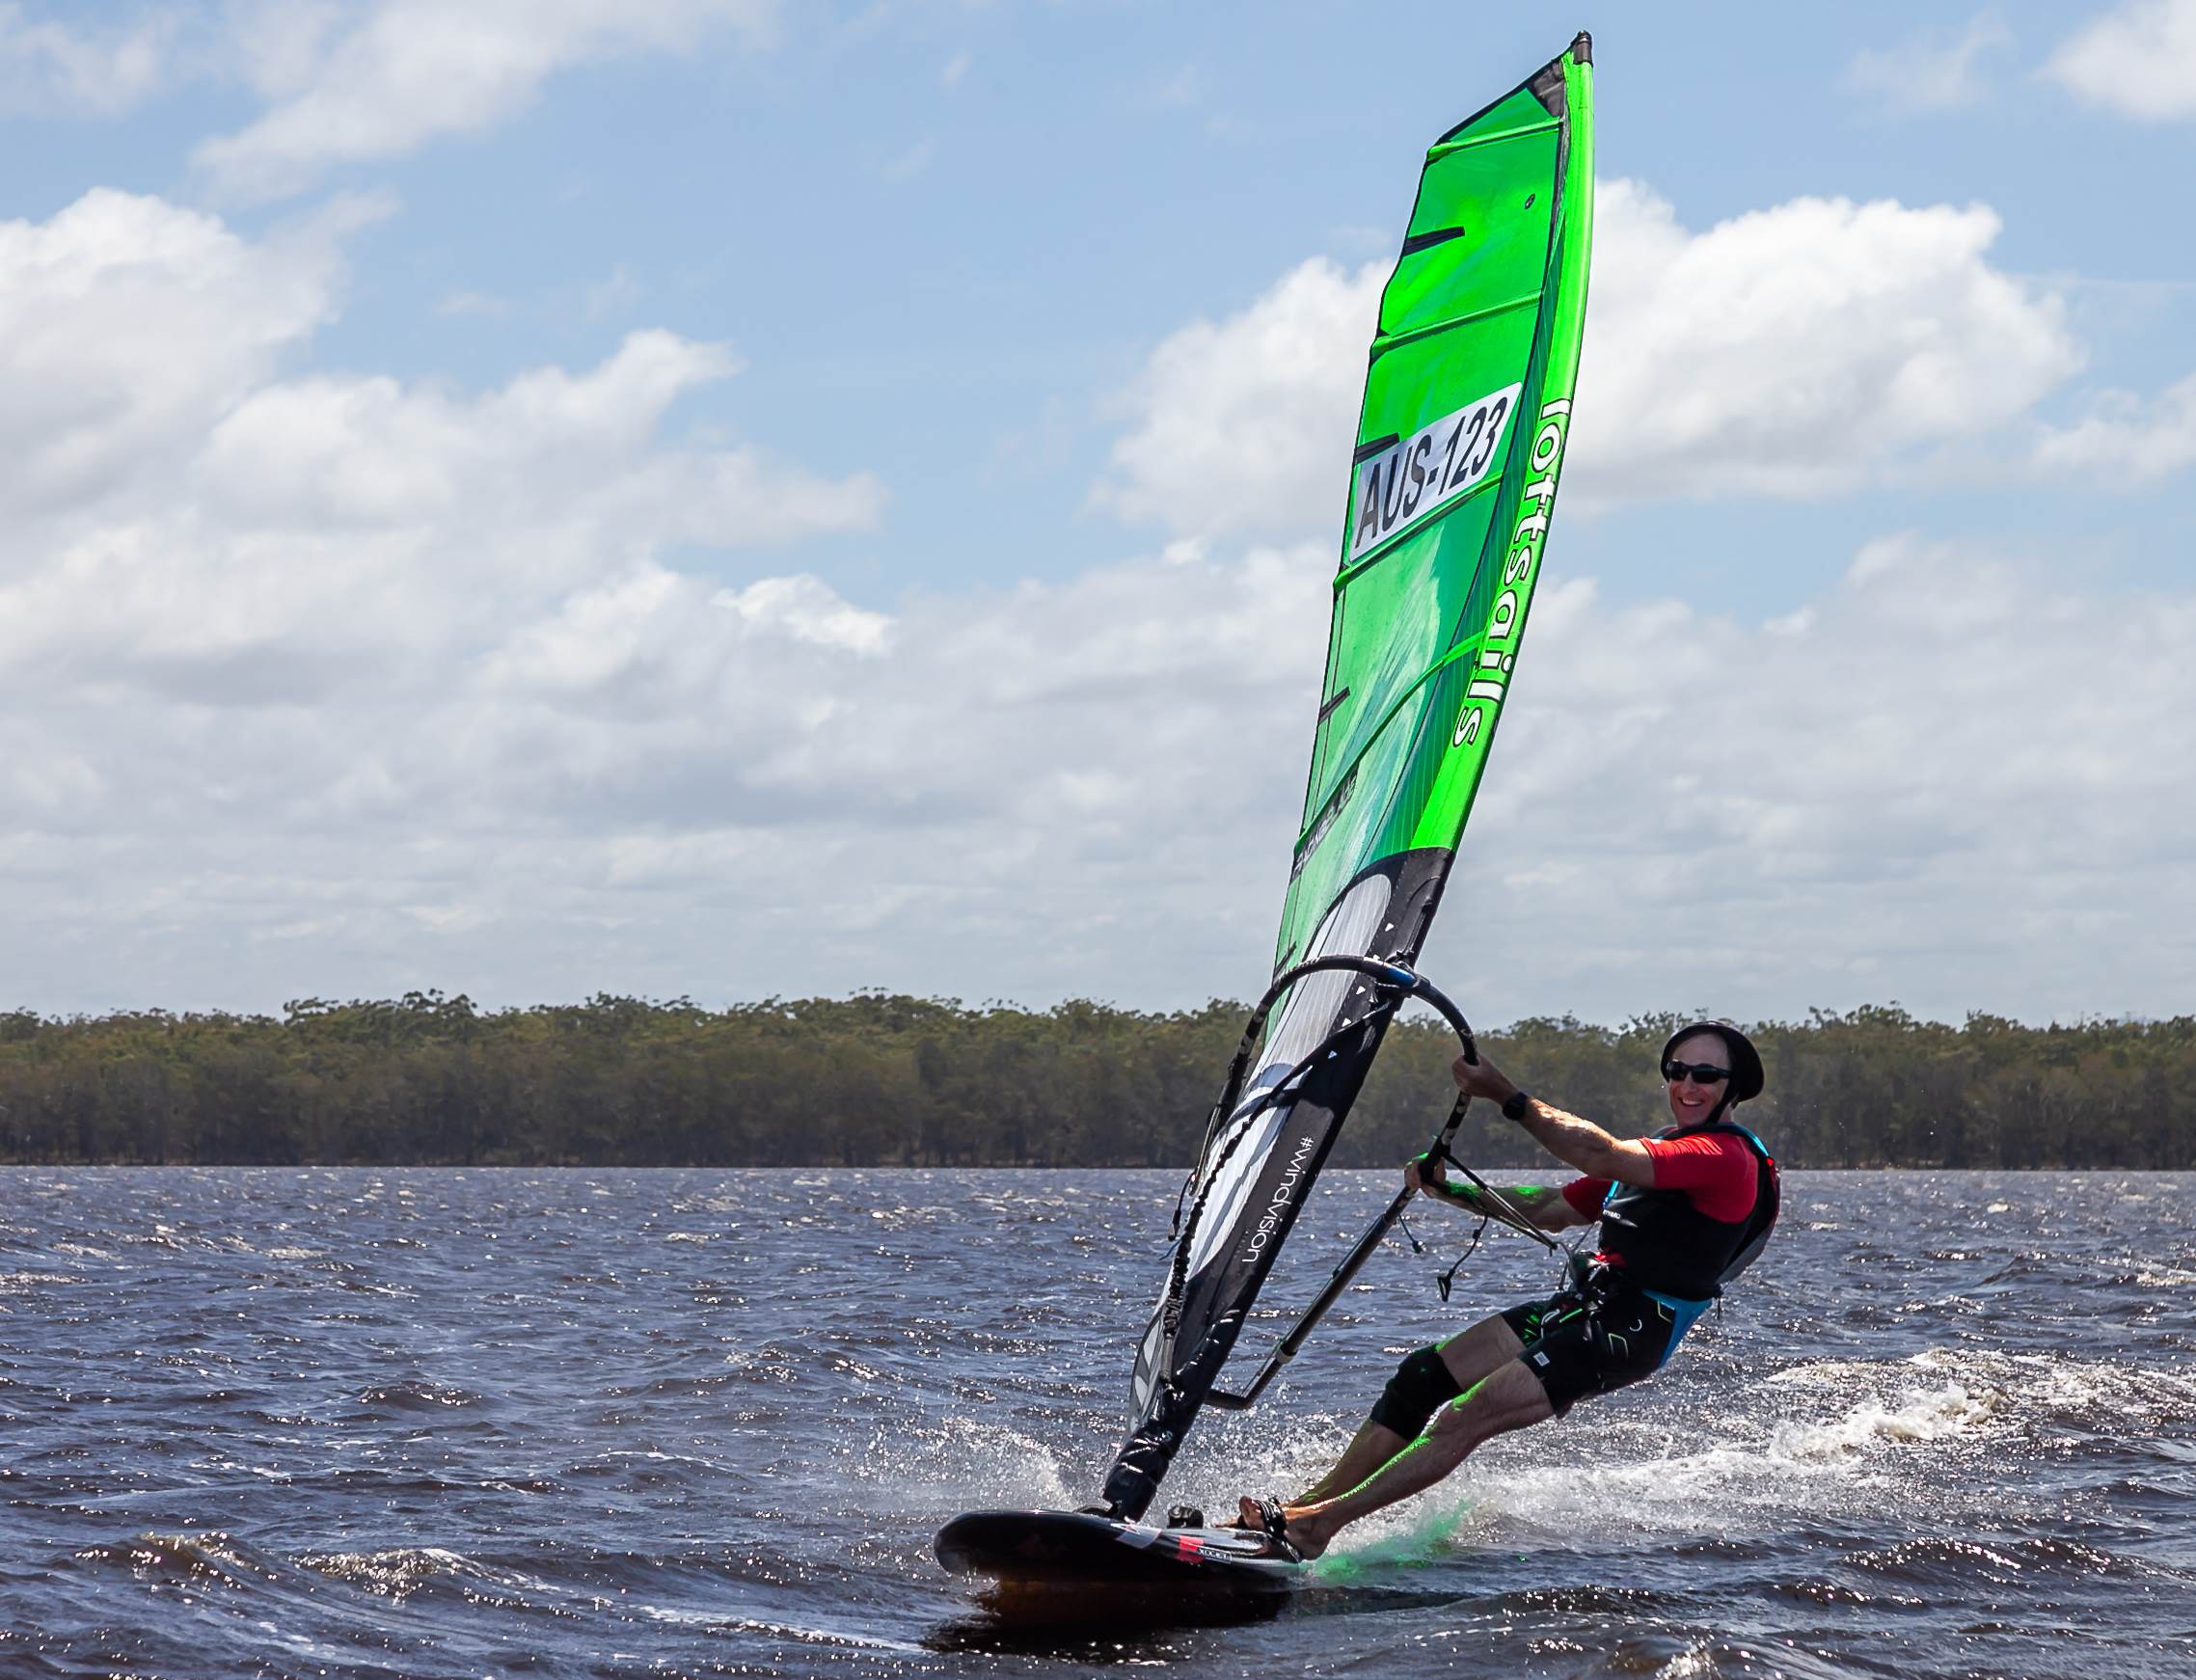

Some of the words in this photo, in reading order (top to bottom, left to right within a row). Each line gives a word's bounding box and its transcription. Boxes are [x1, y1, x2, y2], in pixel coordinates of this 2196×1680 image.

[1354, 396, 1508, 550] AUS-123
[1452, 397, 1571, 748] loftsails
[1241, 1136, 1315, 1263] #windvision
